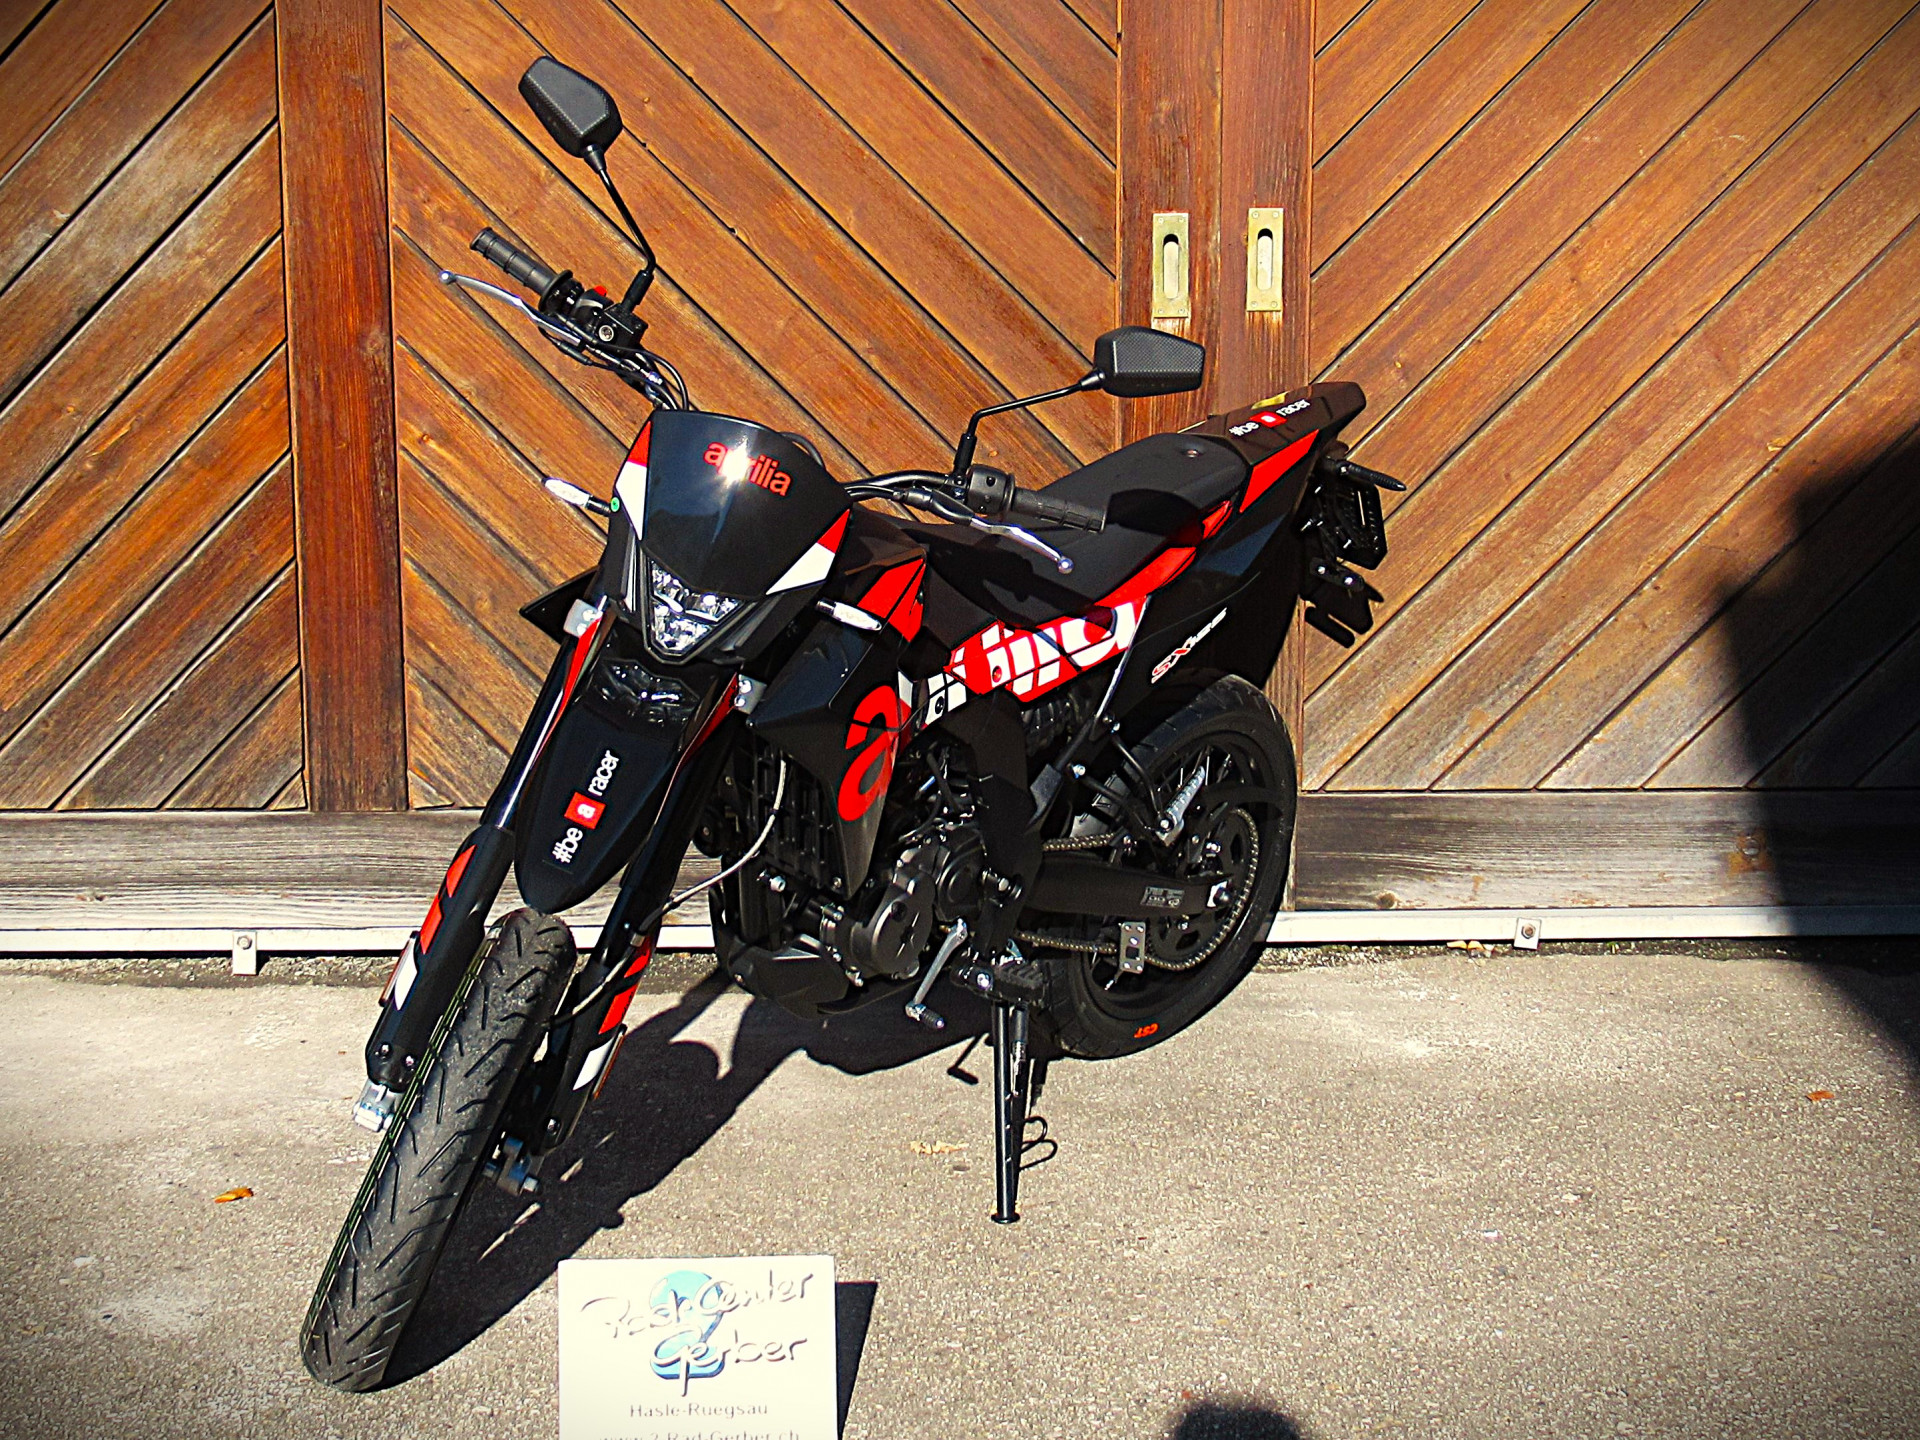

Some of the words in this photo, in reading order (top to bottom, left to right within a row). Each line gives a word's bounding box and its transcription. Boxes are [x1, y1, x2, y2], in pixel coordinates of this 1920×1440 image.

[703, 442, 792, 497] ailia
[552, 827, 583, 863] #be
[577, 803, 596, 819] a
[588, 750, 619, 796] racer
[629, 1402, 769, 1419] Hasle-Ruegsau
